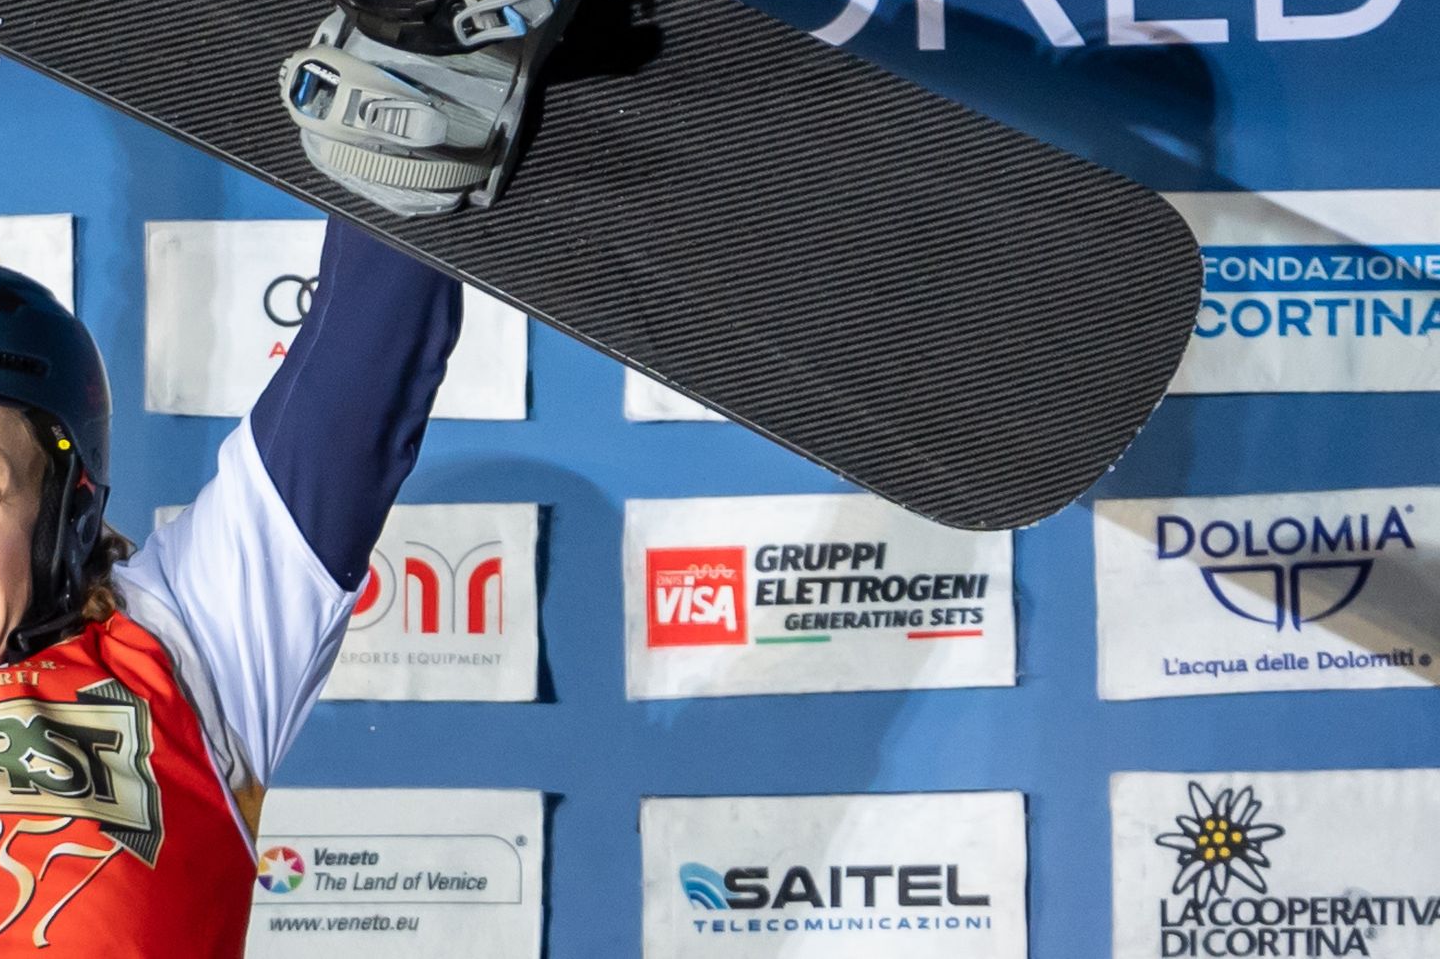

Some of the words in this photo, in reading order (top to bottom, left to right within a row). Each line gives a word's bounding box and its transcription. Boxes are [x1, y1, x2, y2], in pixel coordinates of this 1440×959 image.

[1157, 504, 1416, 560] DOLOMIA
[755, 542, 888, 573] GRUPPI
[755, 573, 989, 606] ELETTROGENI
[784, 611, 924, 631] GENERATING
[930, 607, 985, 626] SETS
[339, 652, 399, 665] SPORTS
[408, 652, 503, 665] EQUIPMENT
[1163, 657, 1249, 678] L'acqua
[1255, 653, 1310, 673] delle
[1316, 648, 1414, 670] Dolomiti
[313, 847, 380, 866] Veneto
[314, 872, 347, 891] The
[353, 872, 398, 891] Land
[403, 872, 423, 891] of
[427, 870, 489, 891] Venice
[723, 864, 992, 910] SAITEL
[269, 915, 420, 931] www.veneto.eu
[693, 917, 992, 934] TELECOMUNICAZIONI
